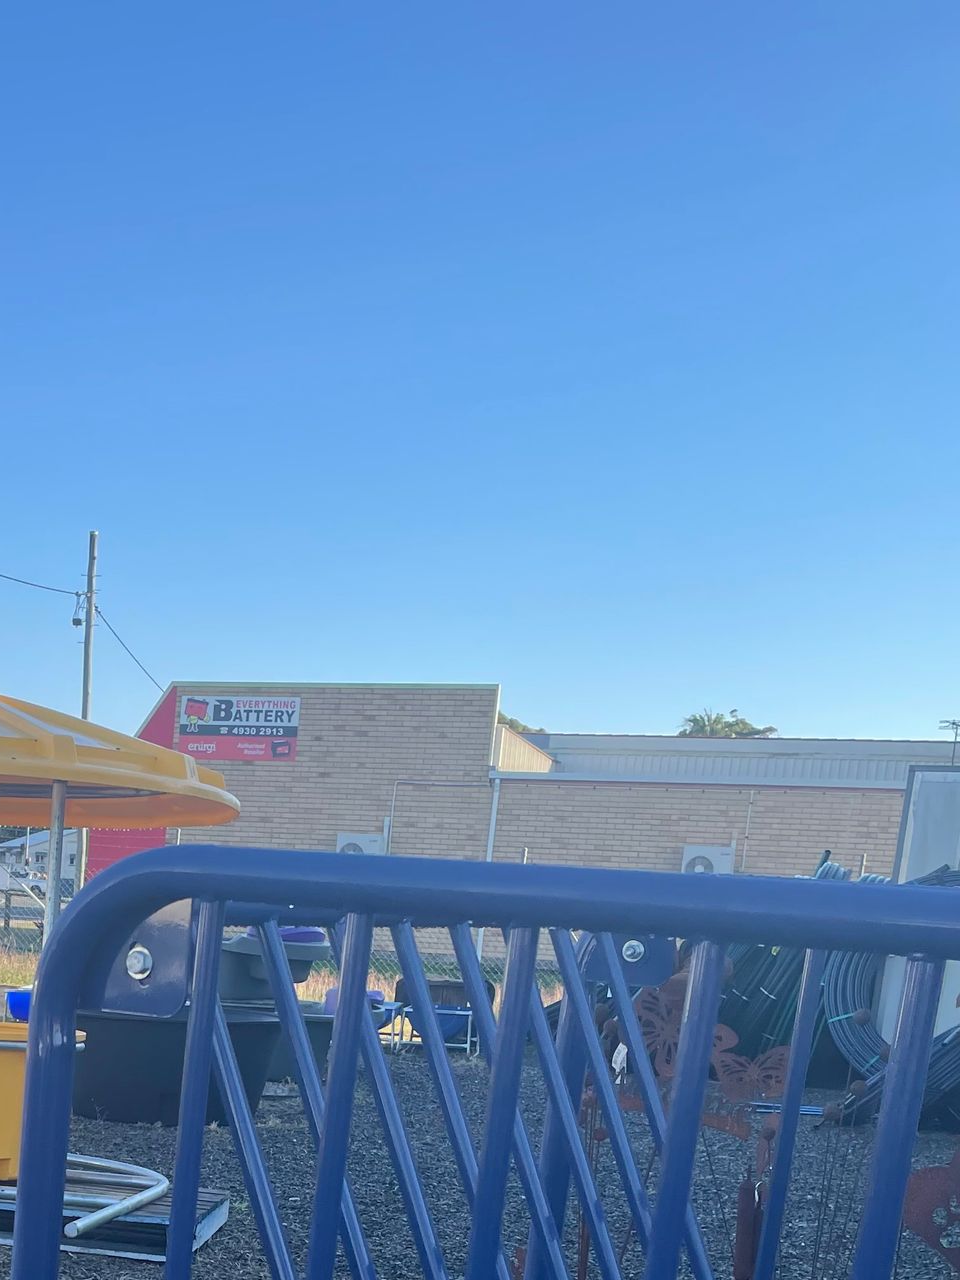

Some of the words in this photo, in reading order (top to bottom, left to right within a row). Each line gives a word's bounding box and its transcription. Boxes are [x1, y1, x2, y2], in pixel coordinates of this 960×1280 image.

[236, 700, 296, 709] EVERYTHING
[213, 699, 296, 723] BATTERY
[232, 727, 256, 735] 4930
[259, 728, 284, 736] 2913
